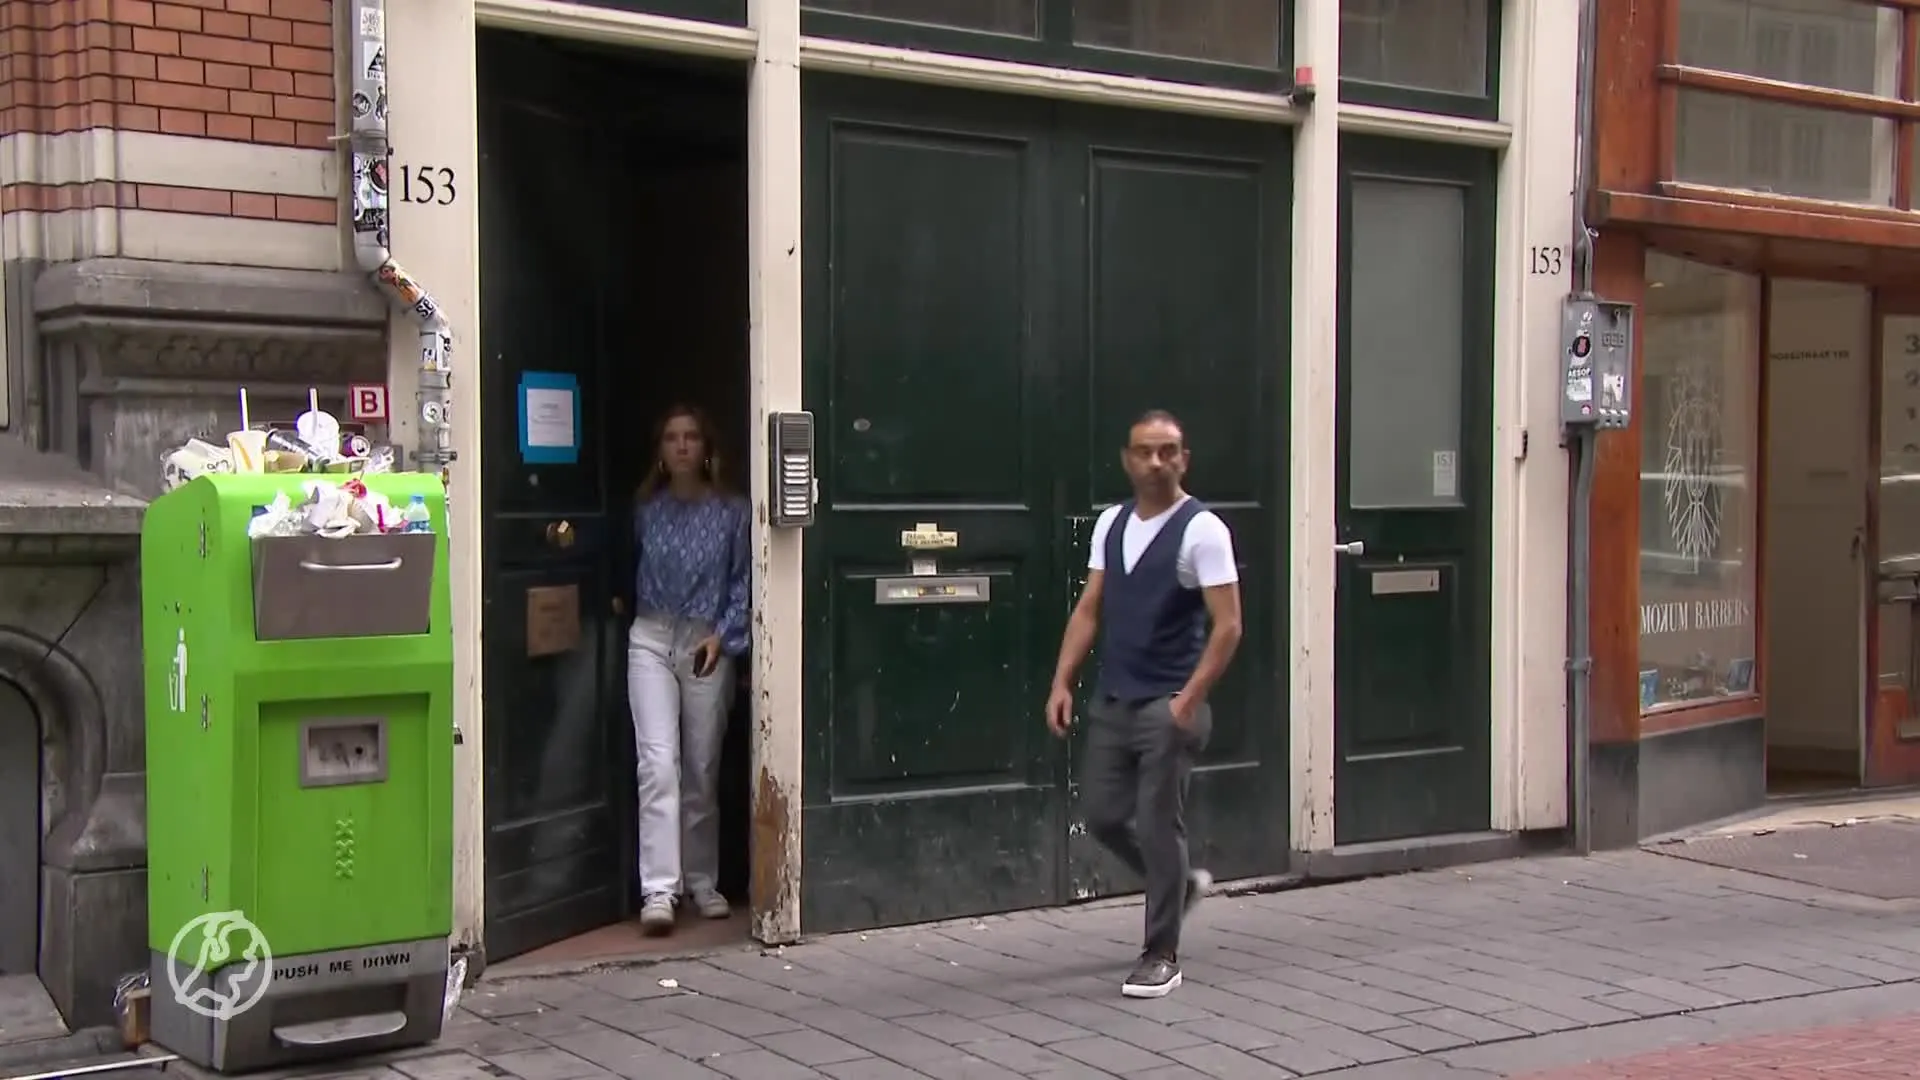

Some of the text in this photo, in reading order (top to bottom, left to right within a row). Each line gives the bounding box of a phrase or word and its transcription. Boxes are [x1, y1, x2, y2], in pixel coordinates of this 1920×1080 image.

[400, 164, 457, 206] 153
[1531, 246, 1562, 276] 153
[360, 390, 378, 414] B
[274, 952, 410, 981] PUSH ME DOWN
